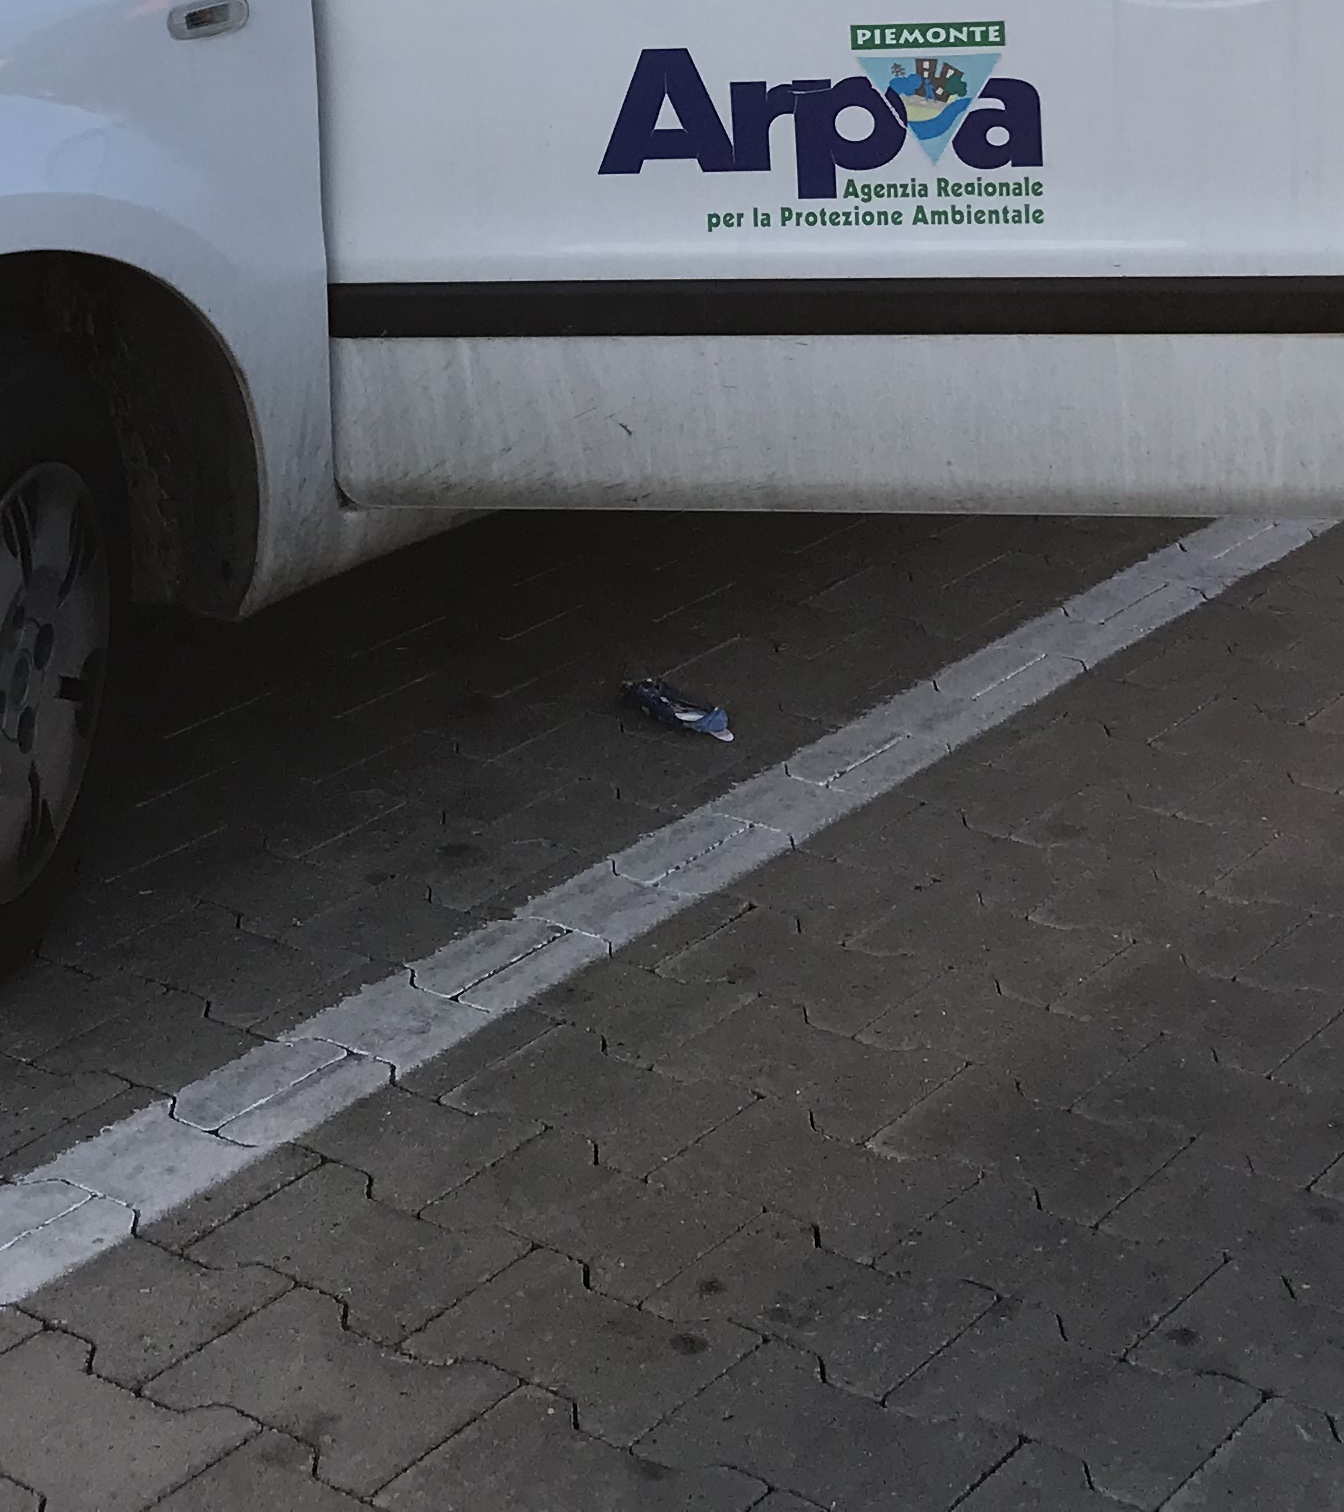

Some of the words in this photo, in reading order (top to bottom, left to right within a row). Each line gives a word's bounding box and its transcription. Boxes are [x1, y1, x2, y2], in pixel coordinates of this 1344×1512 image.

[856, 25, 1001, 45] PIEMONTE
[598, 47, 1044, 199] Arpa
[843, 177, 929, 203] Agenzia
[707, 212, 744, 232] per
[753, 207, 771, 227] la
[780, 205, 904, 227] Protezione
[912, 204, 1045, 226] Ambientale
